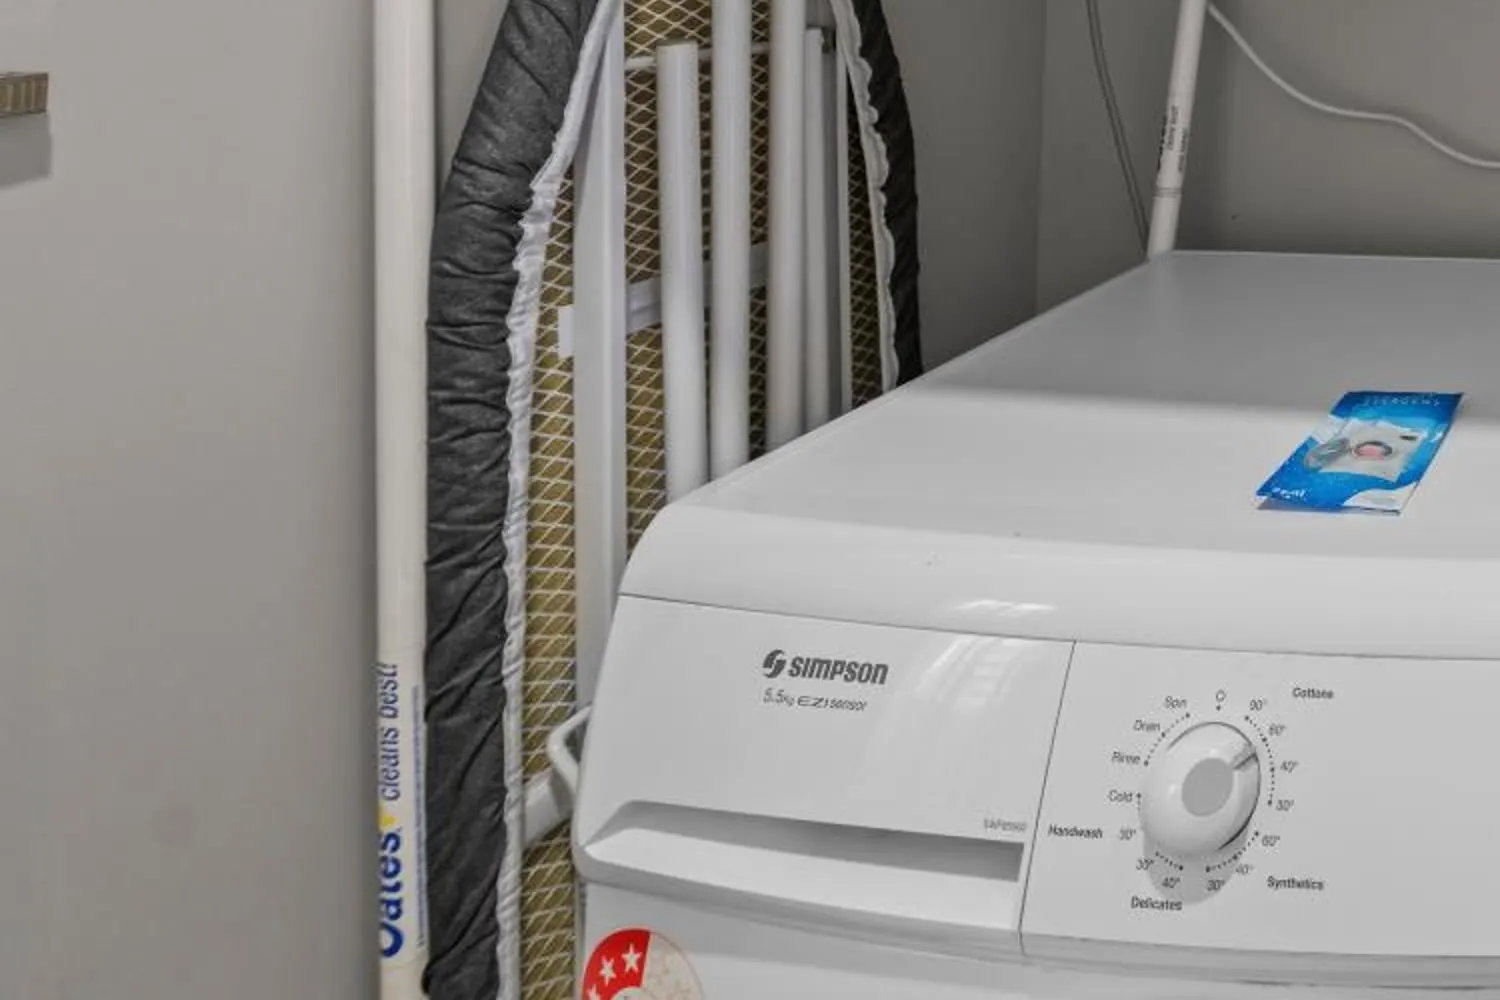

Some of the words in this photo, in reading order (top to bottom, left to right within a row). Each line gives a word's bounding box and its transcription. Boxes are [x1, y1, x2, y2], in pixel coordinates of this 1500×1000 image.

[788, 655, 890, 685] SIMPSON
[1164, 696, 1187, 709] Spin
[1108, 789, 1133, 803] Cold
[1048, 823, 1103, 839] Handwash
[1267, 875, 1325, 891] Synthetics
[1130, 896, 1183, 912] Delicates
